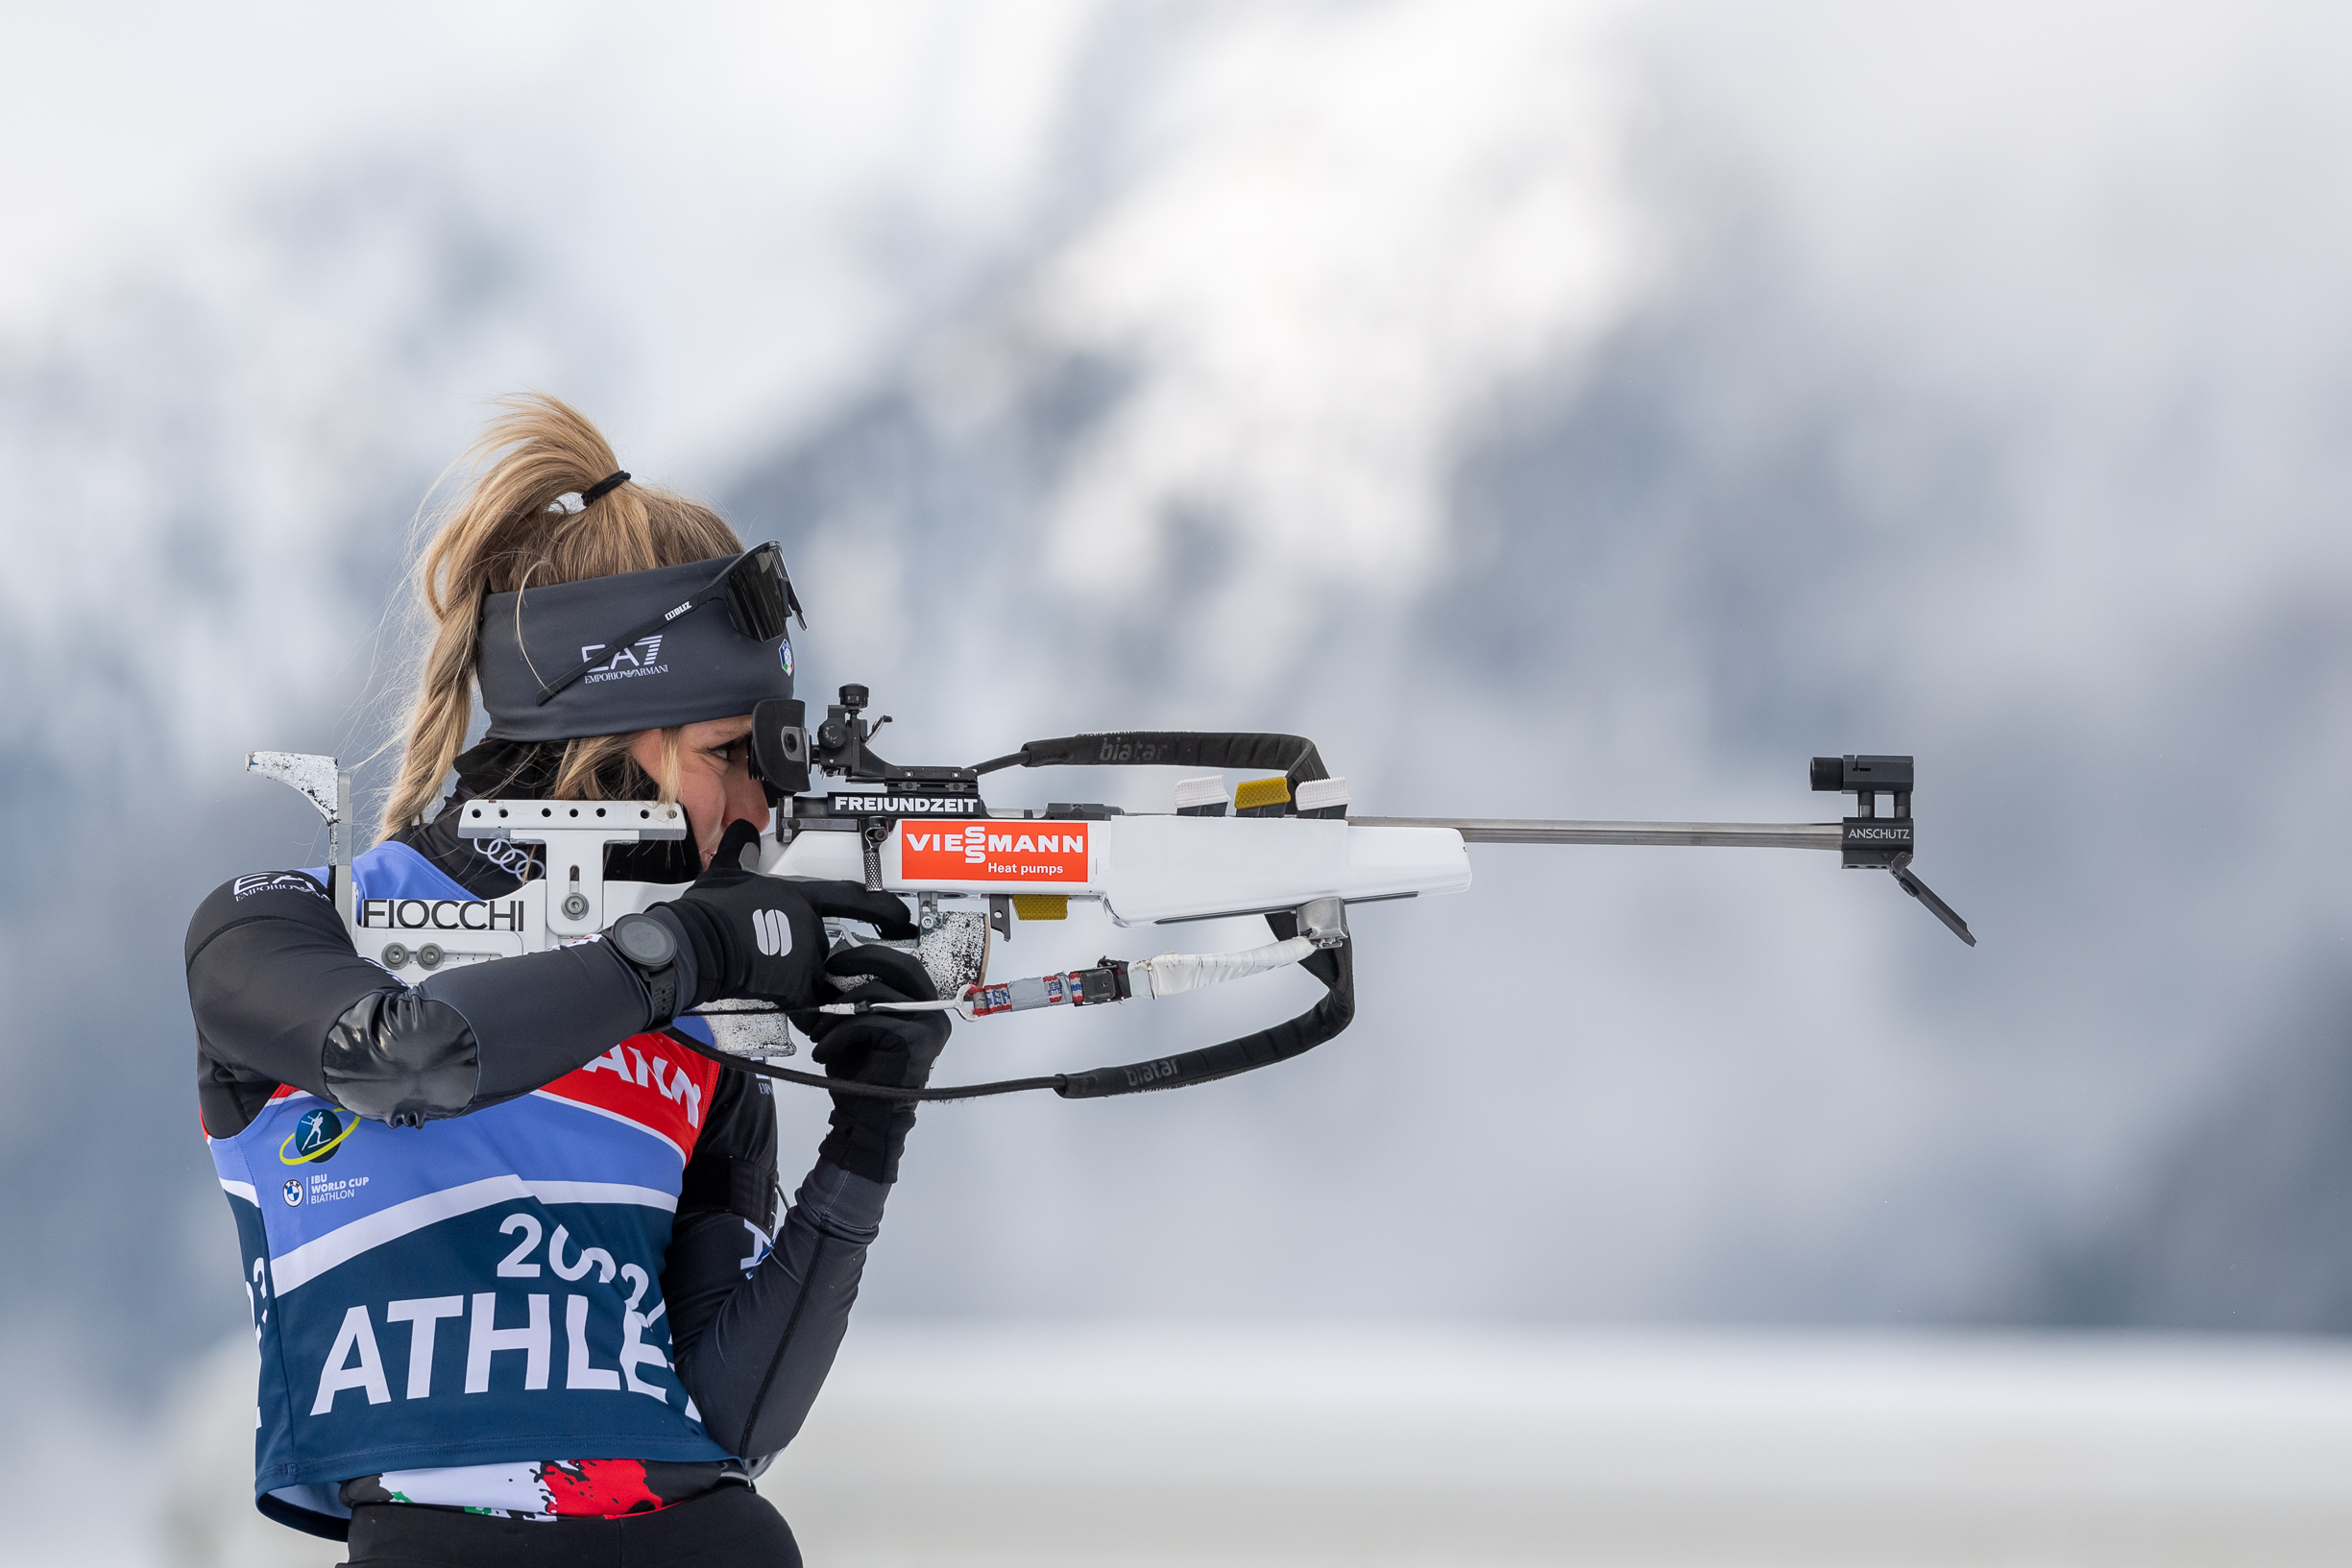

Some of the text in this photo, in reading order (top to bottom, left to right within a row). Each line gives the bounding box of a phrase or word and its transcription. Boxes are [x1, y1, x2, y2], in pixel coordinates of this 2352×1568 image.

[581, 635, 663, 672] EA7
[584, 664, 669, 684] EMPORIO ARMANI
[1848, 828, 1910, 839] ANSCHÜTZ
[906, 826, 1083, 864] VIESSMANN
[988, 862, 1063, 875] Heat pumps
[363, 899, 524, 931] FIOCCHI
[310, 1173, 327, 1185] IBU
[310, 1176, 370, 1194] WORLD CUP
[310, 1189, 355, 1204] BIATHLON
[309, 1291, 702, 1423] ATHLE
